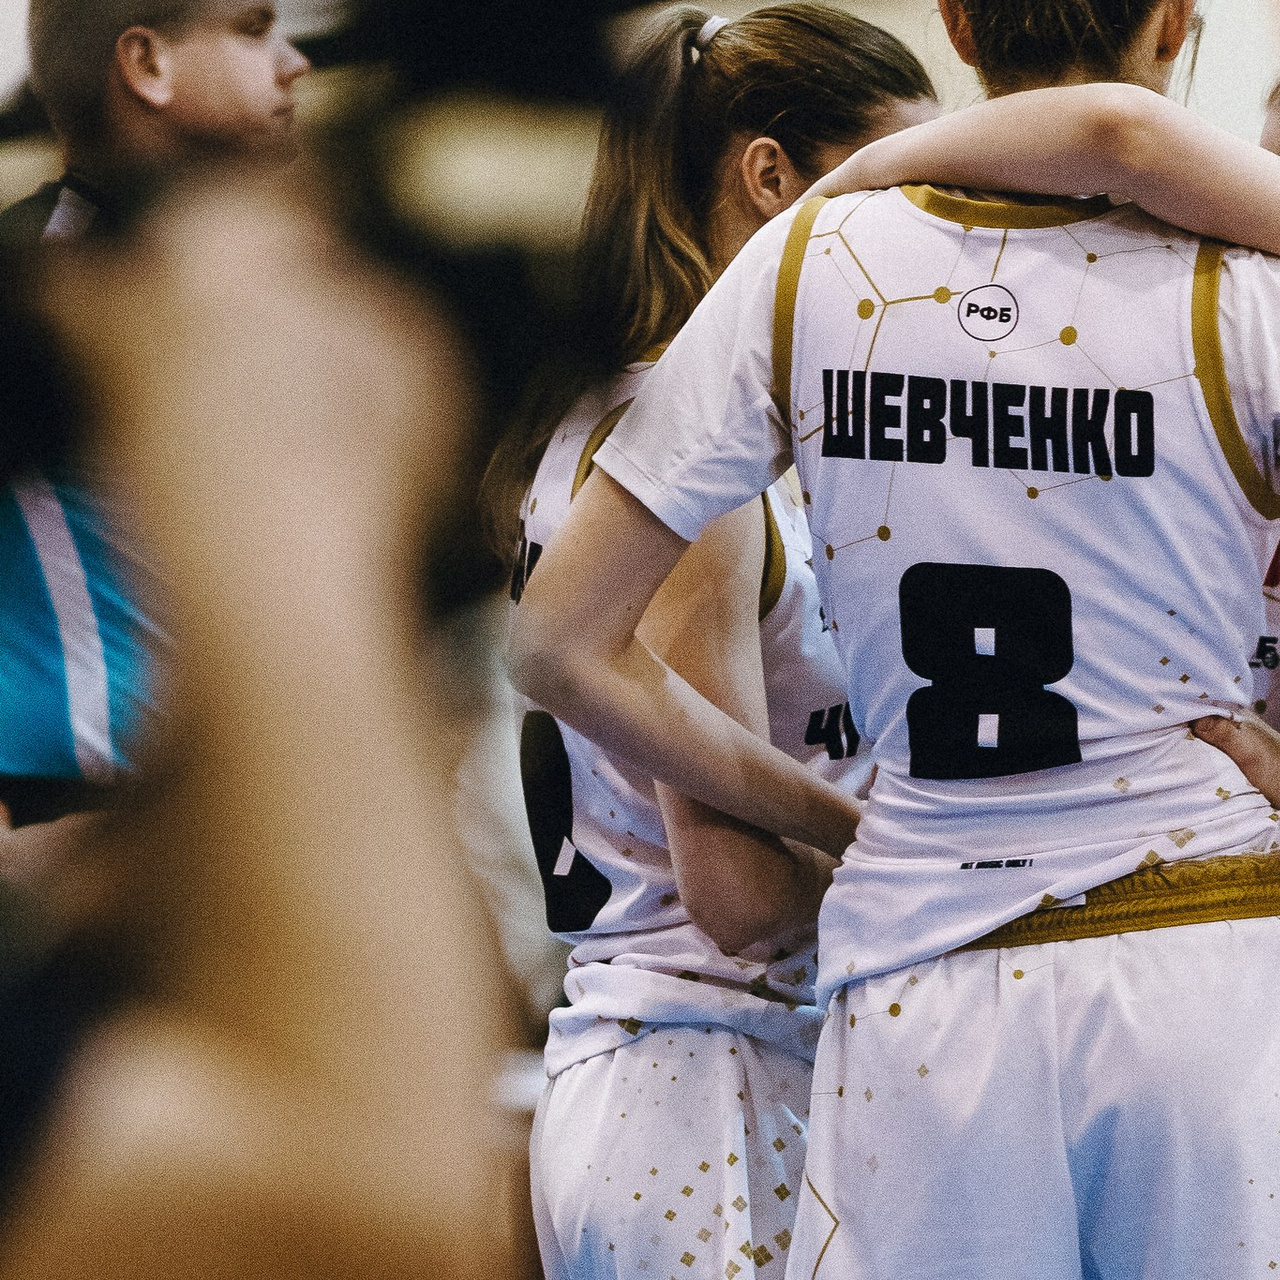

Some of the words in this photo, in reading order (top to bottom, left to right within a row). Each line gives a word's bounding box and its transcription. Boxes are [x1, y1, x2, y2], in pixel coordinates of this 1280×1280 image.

[966, 303, 1012, 323] РФБ
[821, 368, 1155, 478] ШЕВЧЕНКО
[898, 561, 1082, 780] 8
